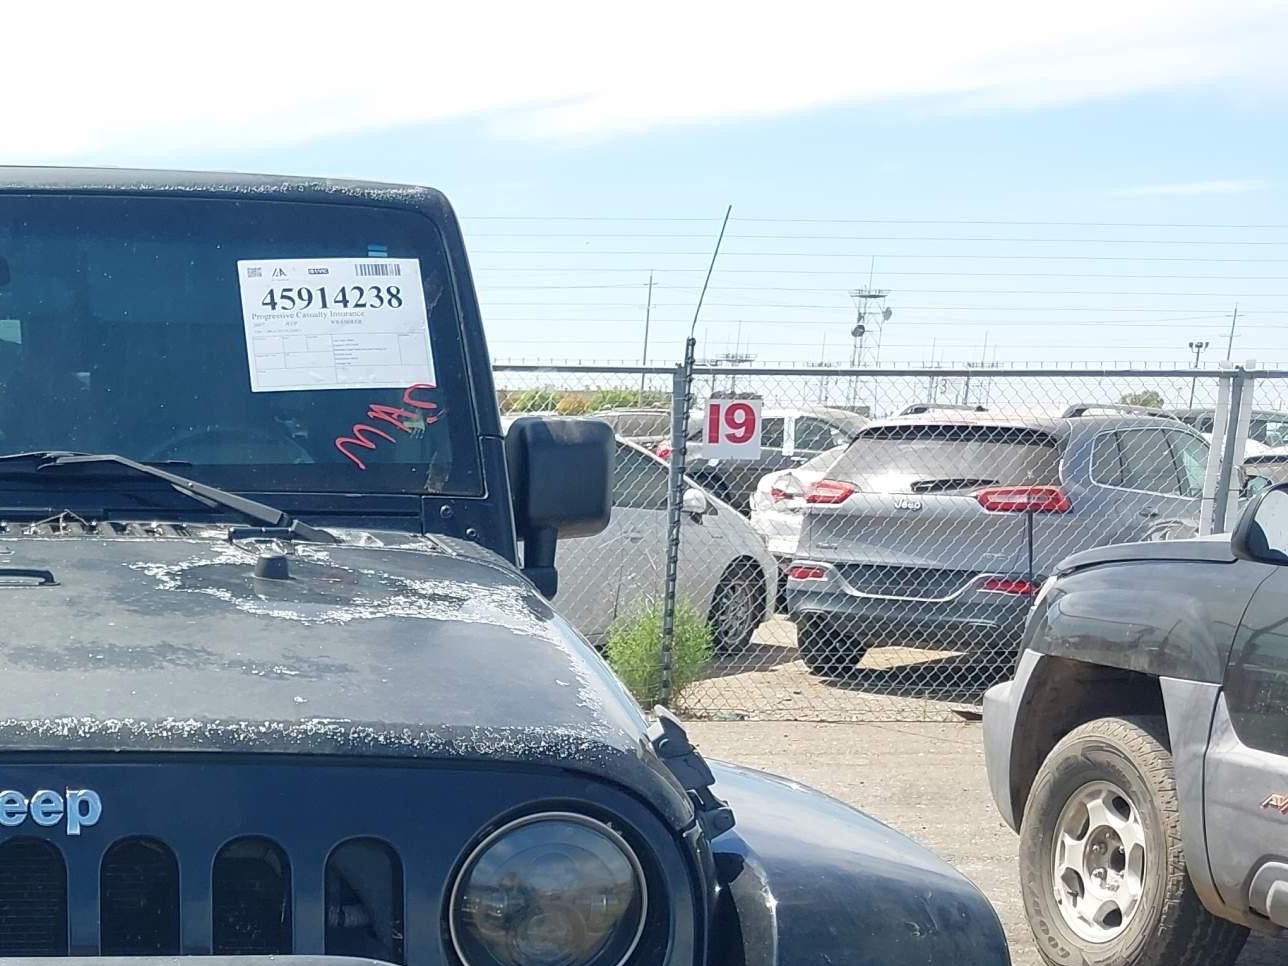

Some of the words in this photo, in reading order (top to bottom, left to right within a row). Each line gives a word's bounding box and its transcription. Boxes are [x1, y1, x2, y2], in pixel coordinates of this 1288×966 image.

[261, 285, 403, 311] 45914238
[251, 312, 295, 321] Progressive
[296, 310, 328, 320] Casualty
[330, 309, 365, 318] Insurance
[708, 402, 756, 444] 19
